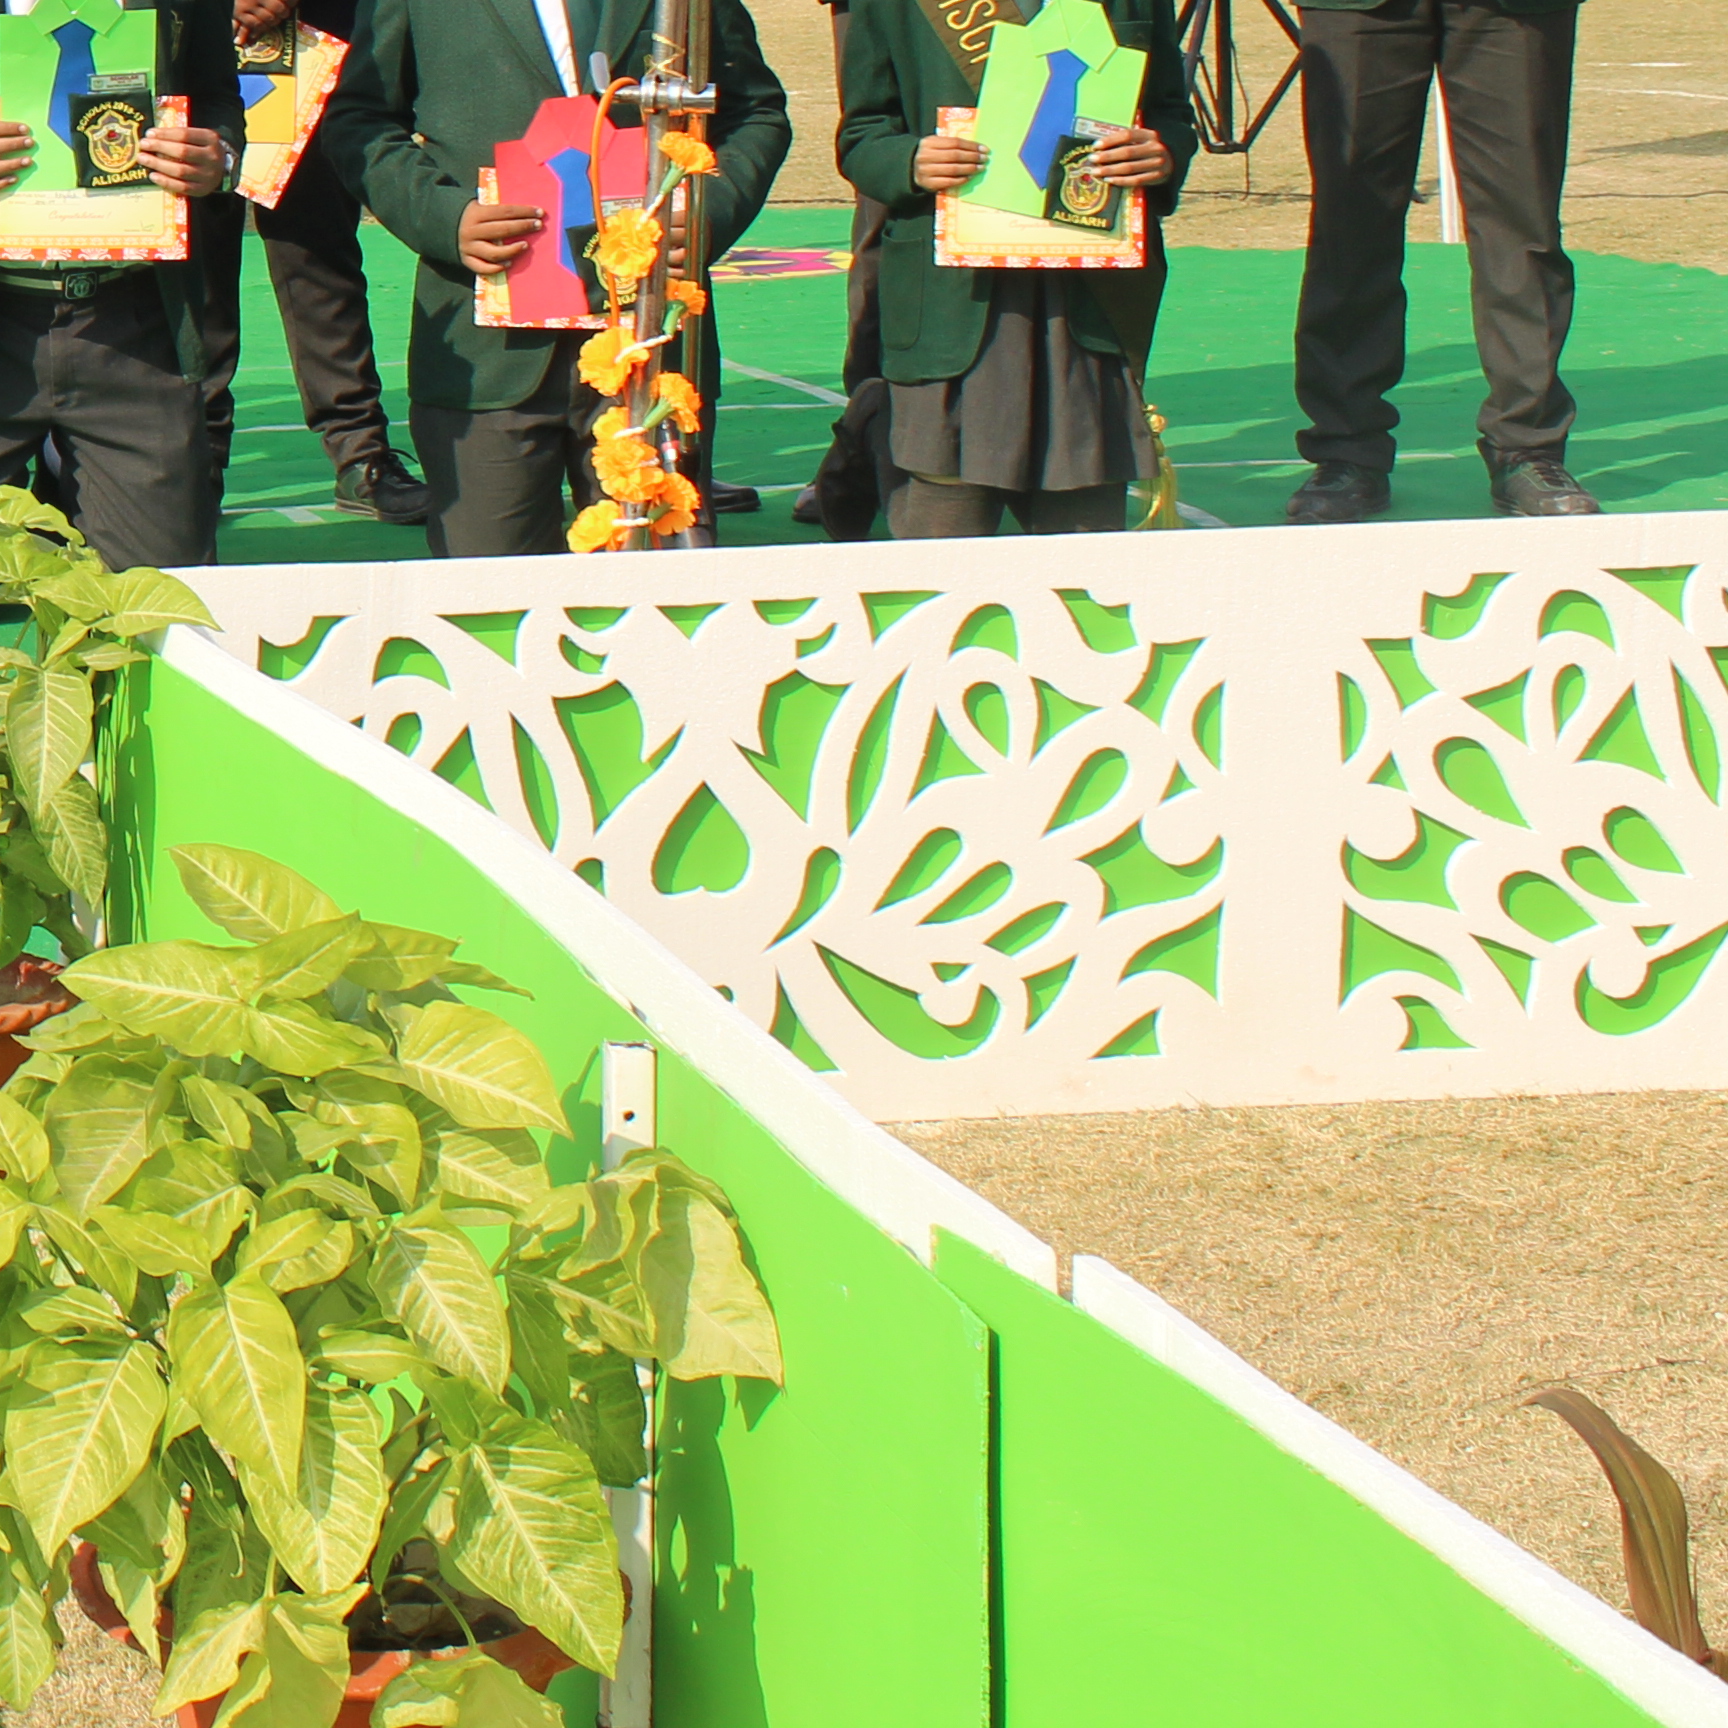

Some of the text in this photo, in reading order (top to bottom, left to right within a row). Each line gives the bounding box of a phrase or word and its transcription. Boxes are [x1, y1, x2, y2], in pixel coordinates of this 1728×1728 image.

[76, 101, 145, 131] SCHOLAR 2016-17
[92, 168, 147, 187] ALIGARH
[1052, 211, 1107, 228] ALIGARH
[582, 232, 601, 258] SCHO
